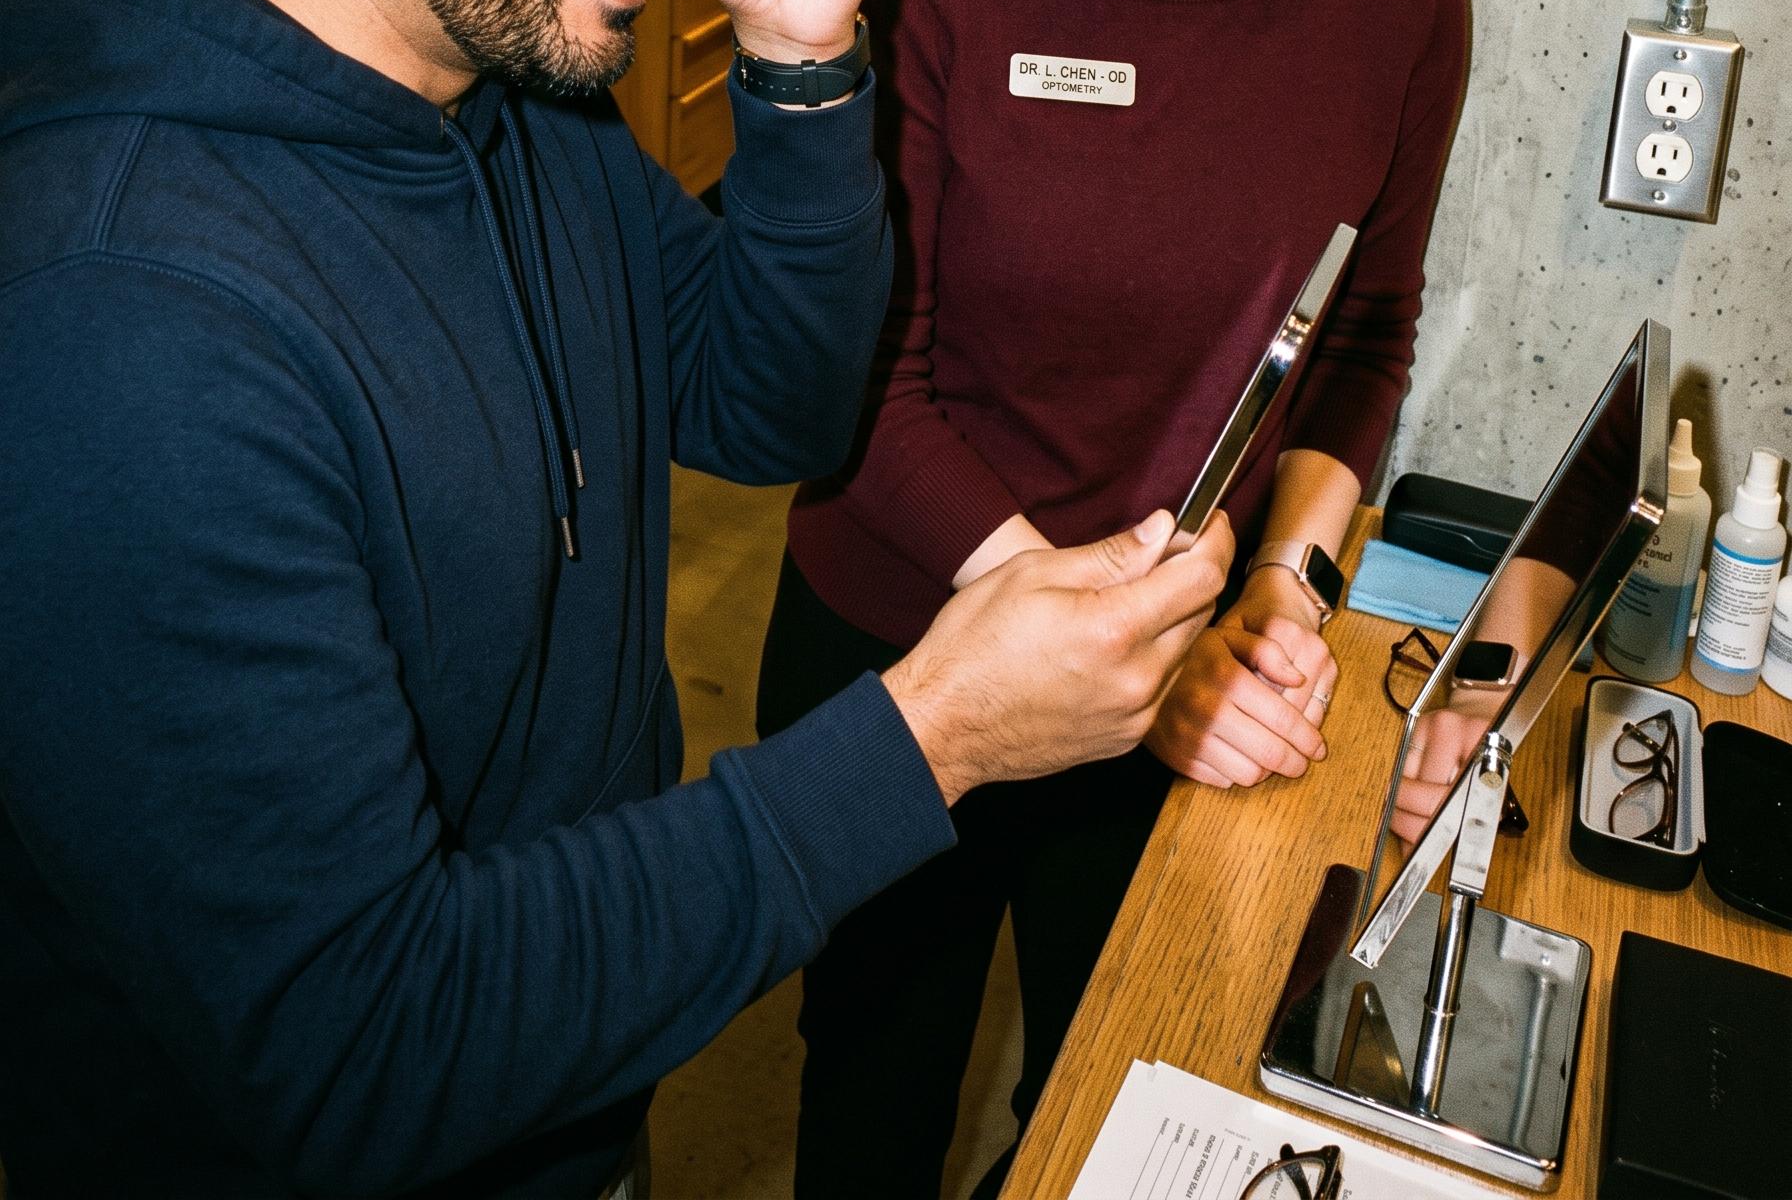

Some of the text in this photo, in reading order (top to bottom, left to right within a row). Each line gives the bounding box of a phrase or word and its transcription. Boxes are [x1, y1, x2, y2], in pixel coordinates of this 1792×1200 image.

[1019, 61, 1041, 76] DR.
[1045, 64, 1056, 77] L.
[1060, 65, 1096, 81] CHEN
[1108, 70, 1127, 84] OD
[1041, 80, 1103, 95] OPTOMETRY
